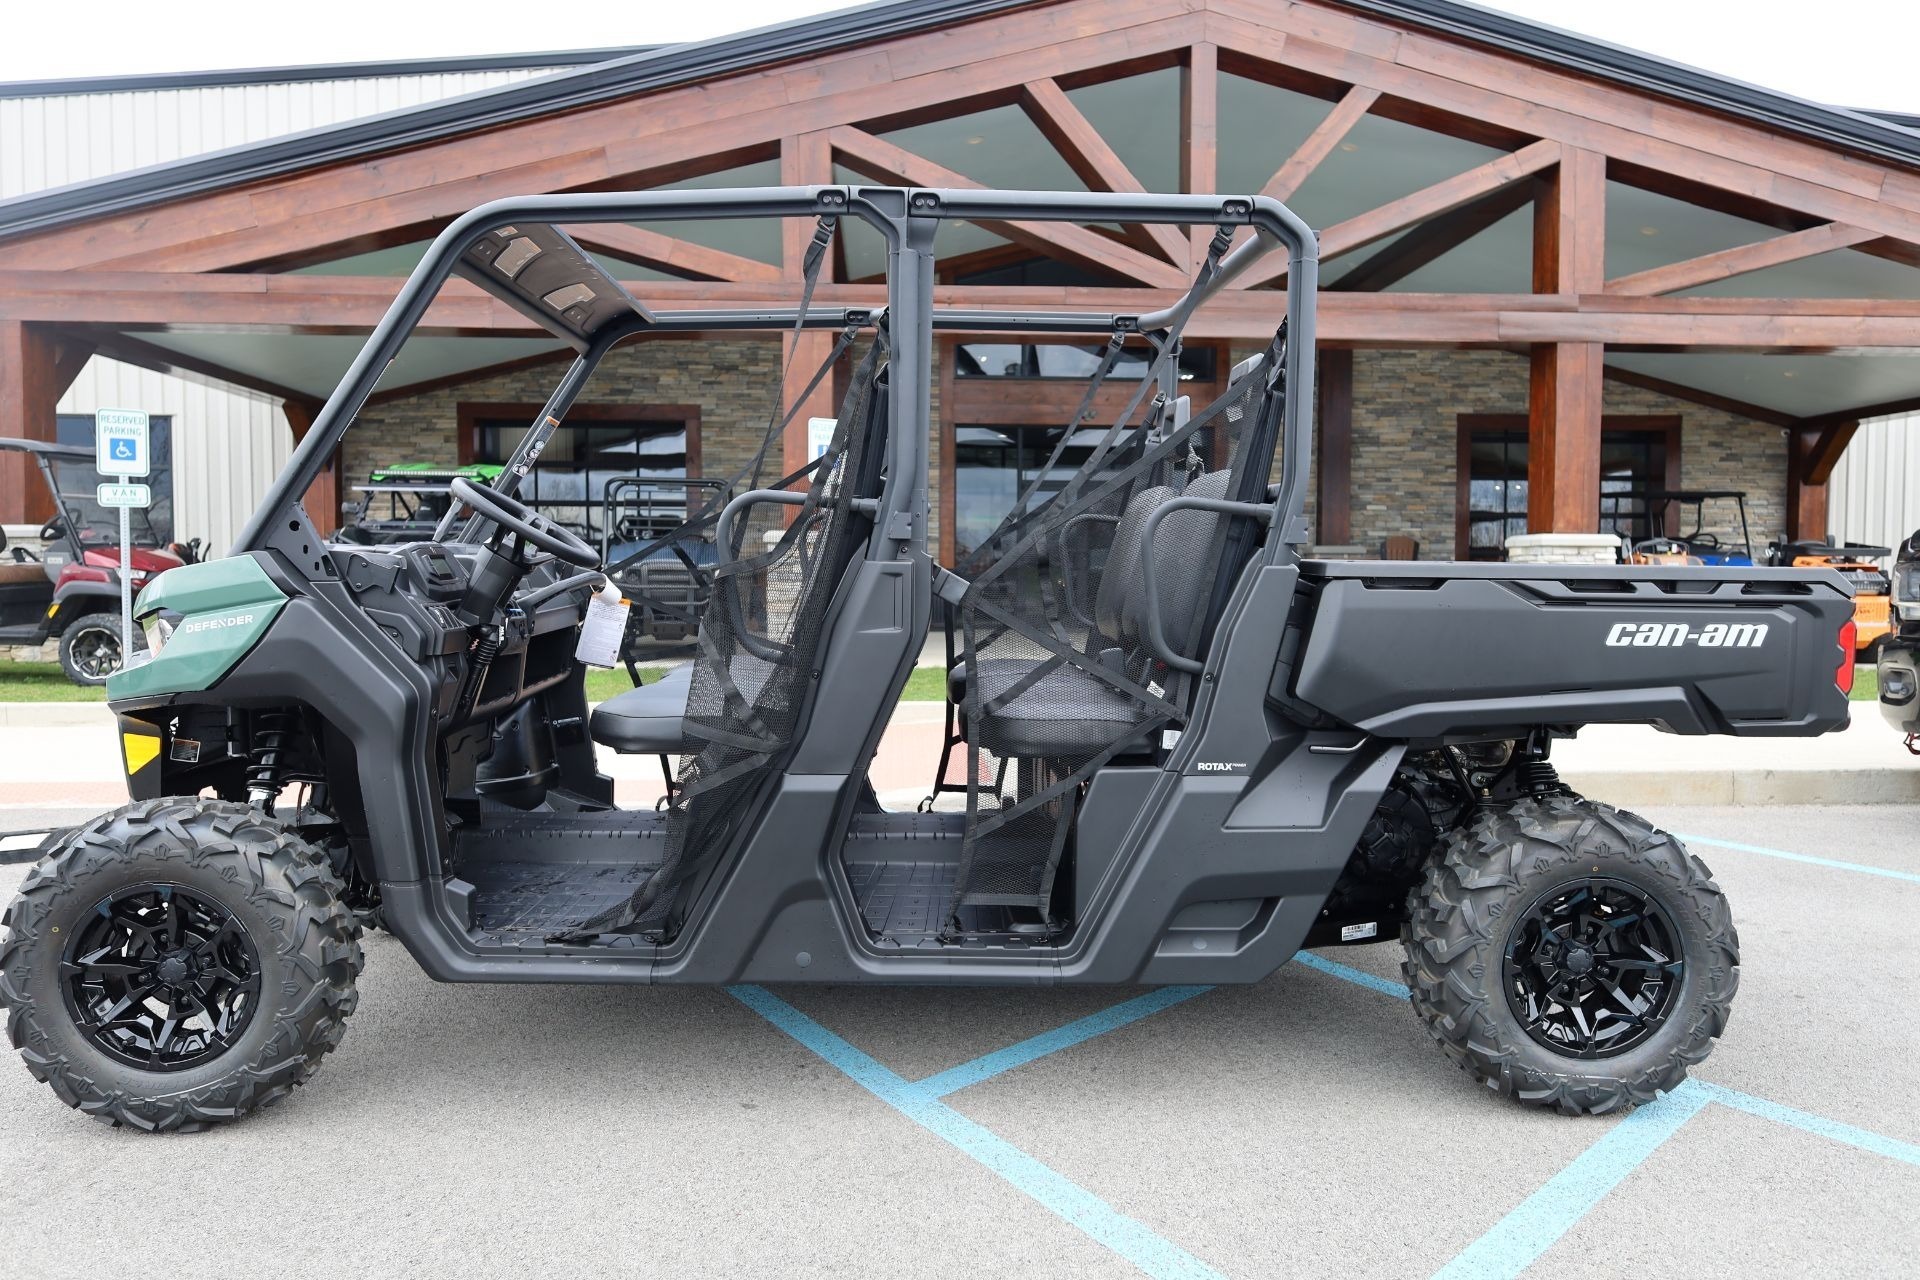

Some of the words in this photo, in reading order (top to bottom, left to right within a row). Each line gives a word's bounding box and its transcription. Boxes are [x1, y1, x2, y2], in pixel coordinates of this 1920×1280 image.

[101, 414, 145, 425] RESERVED
[103, 425, 142, 436] PARKING
[112, 489, 137, 497] VAN
[185, 614, 254, 634] DEFENDER
[1197, 762, 1232, 771] ROTAX
